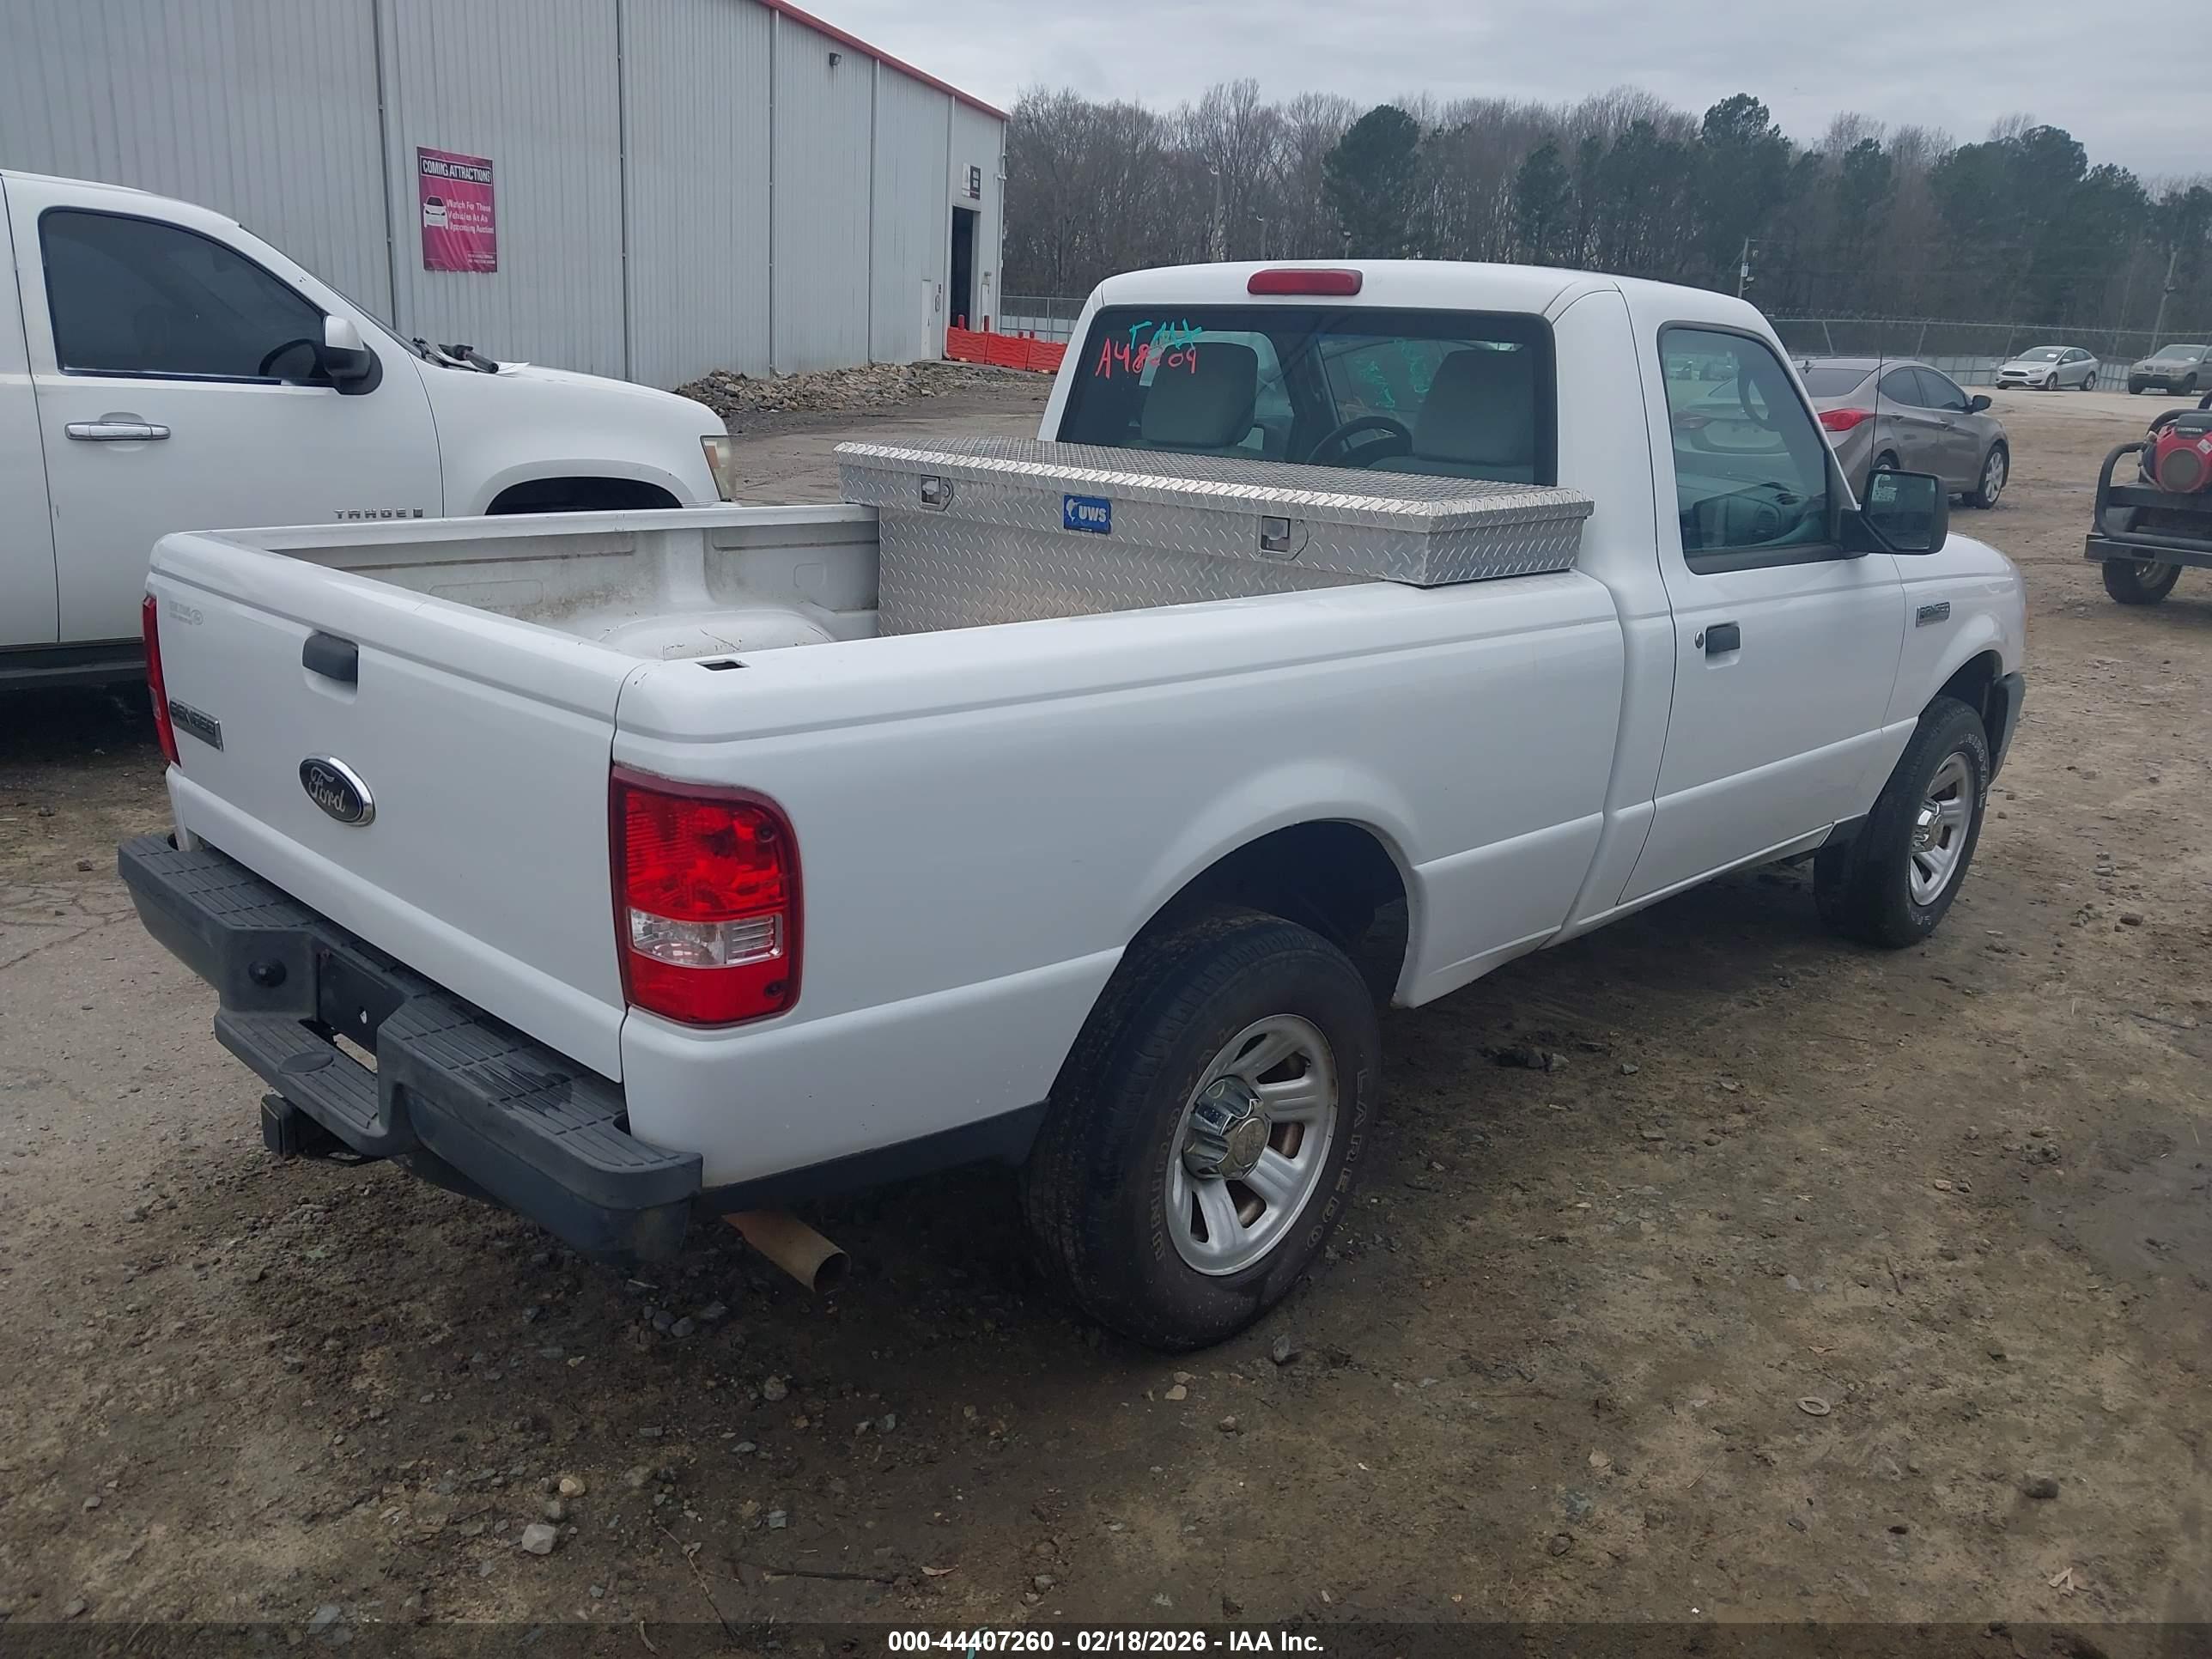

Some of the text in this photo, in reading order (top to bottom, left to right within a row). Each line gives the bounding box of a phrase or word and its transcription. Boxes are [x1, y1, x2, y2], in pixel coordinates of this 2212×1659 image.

[422, 160, 490, 183] COMING ATTRACTIONS
[447, 198, 465, 210] Watch
[466, 201, 475, 211] For
[447, 210, 471, 221] Vehicles
[333, 507, 407, 520] TAHOE
[1079, 505, 1107, 522] UWS
[309, 766, 346, 812] Ford
[1306, 1069, 1368, 1249] LAREDO
